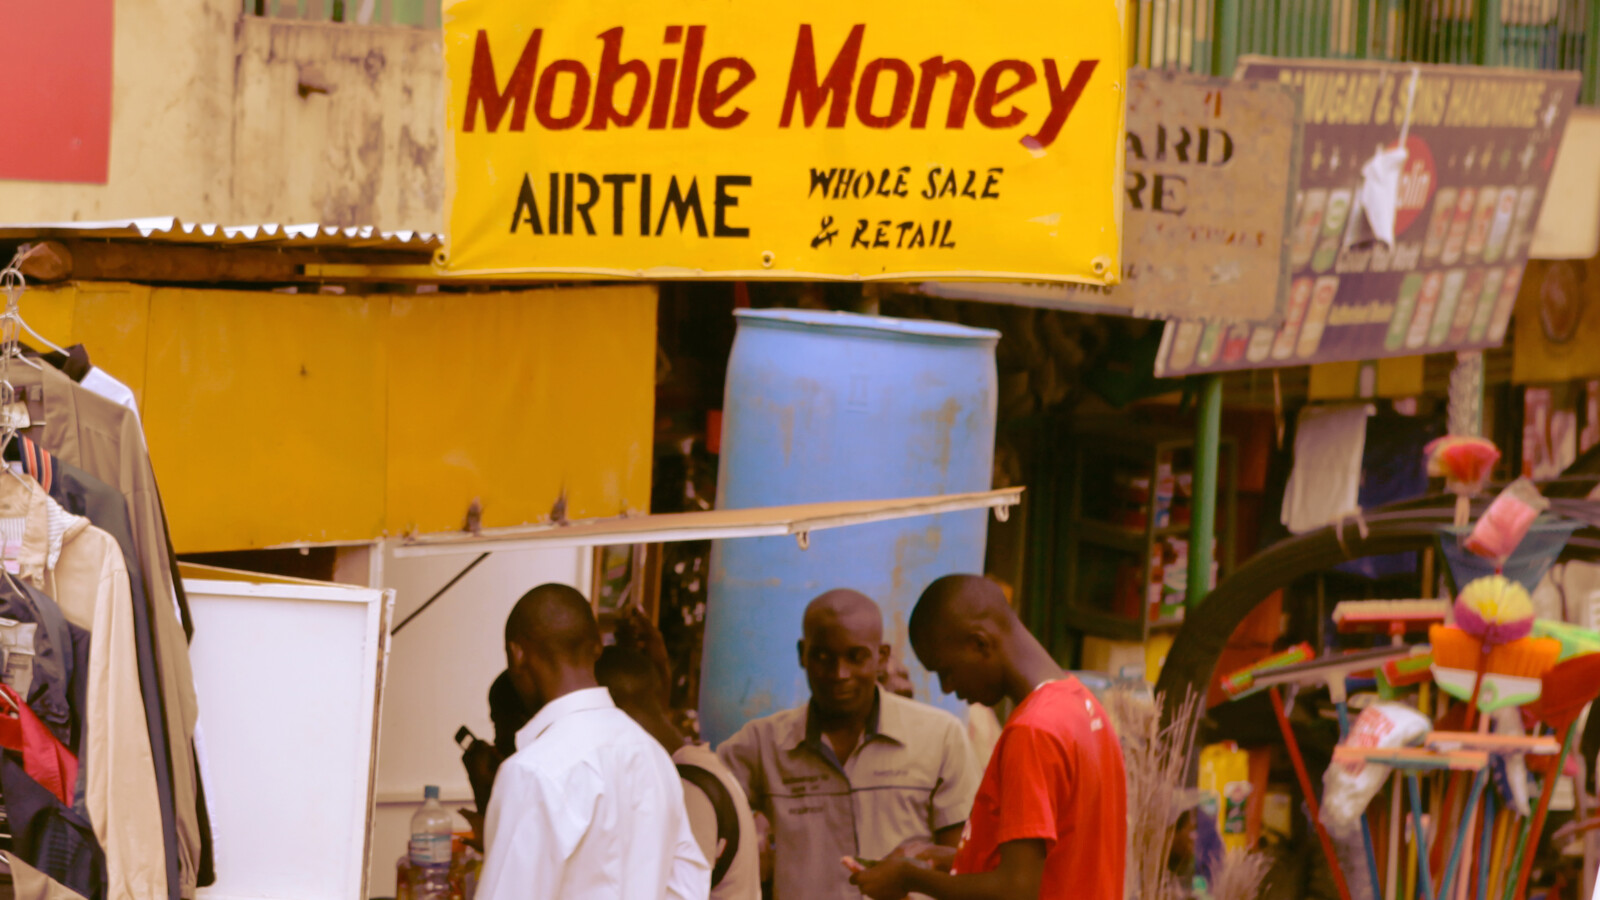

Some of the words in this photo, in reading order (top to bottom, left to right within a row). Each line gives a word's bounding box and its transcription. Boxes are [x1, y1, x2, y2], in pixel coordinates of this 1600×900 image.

[462, 24, 757, 133] Mobile
[778, 23, 1100, 149] Money
[510, 172, 752, 238] AIRTIME
[809, 166, 911, 199] WHOLE
[921, 167, 1004, 200] SALE
[810, 215, 839, 249] &
[850, 219, 956, 249] RETAIL
